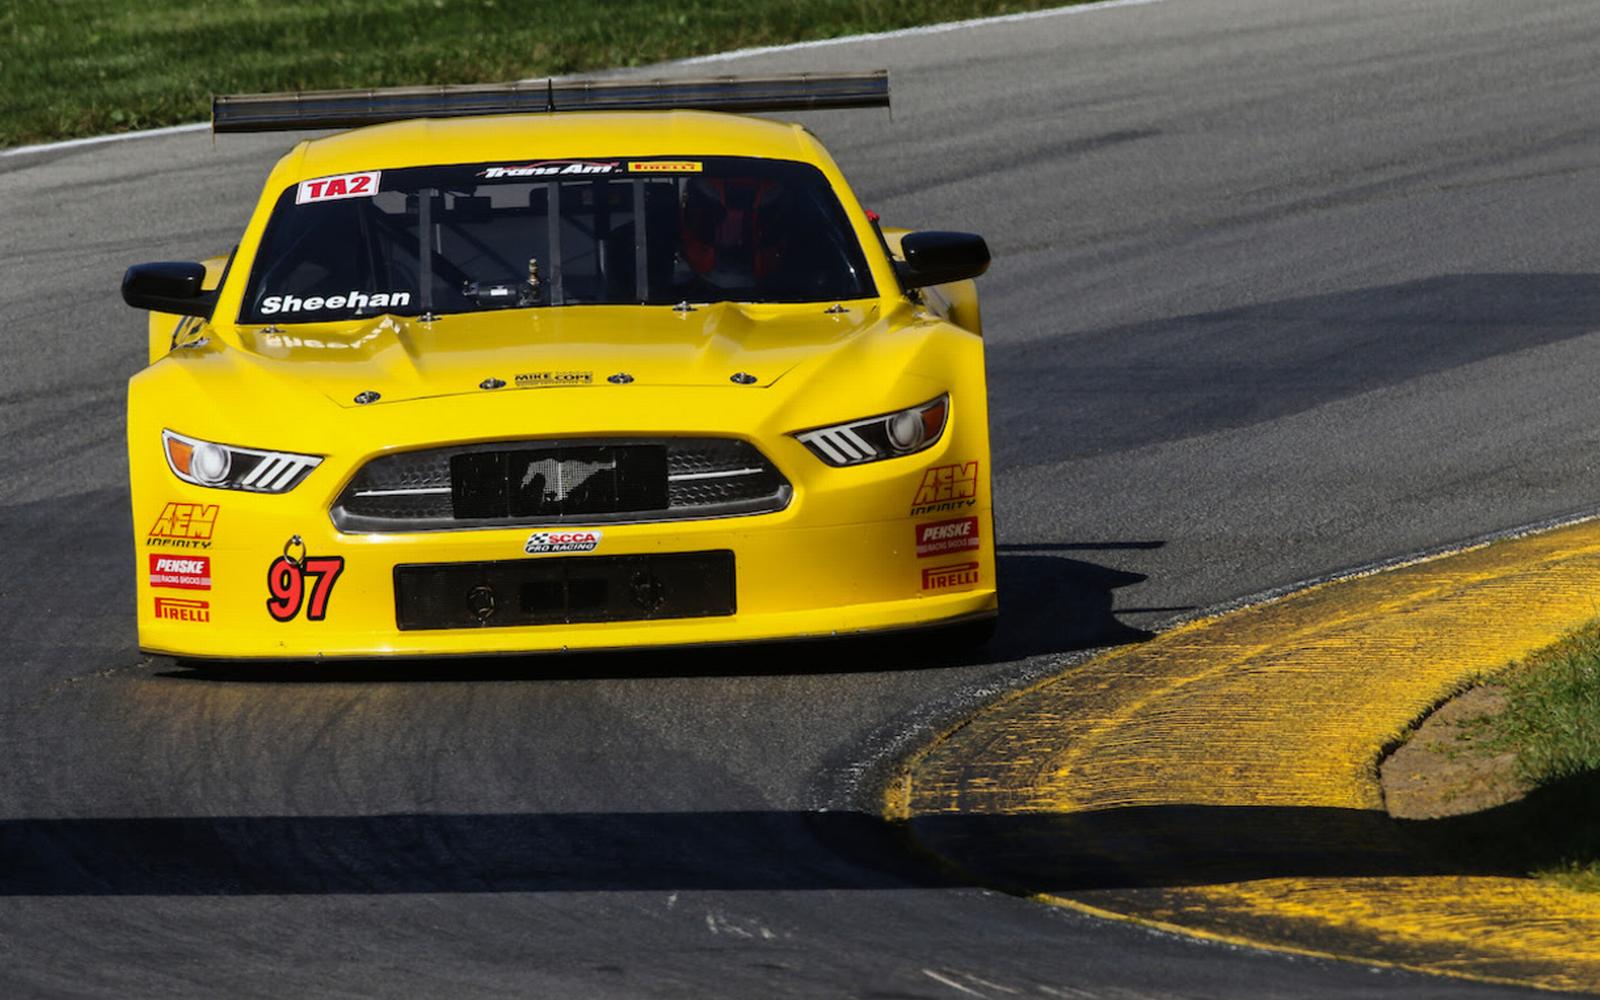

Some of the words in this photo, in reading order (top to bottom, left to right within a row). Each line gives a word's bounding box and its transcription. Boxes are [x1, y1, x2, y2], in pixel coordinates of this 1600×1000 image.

[485, 167, 560, 178] Trans
[560, 163, 612, 174] Am
[308, 176, 371, 198] TA2
[261, 291, 410, 315] Sheehan
[515, 373, 549, 382] MIKE
[554, 371, 592, 382] COPE
[911, 461, 978, 506] AEM
[910, 499, 976, 516] INFINITY
[149, 502, 220, 539] AEM
[548, 533, 596, 544] SCCA
[923, 521, 972, 541] PENSKE
[147, 538, 212, 549] INFINITY
[551, 543, 594, 552] RACING
[155, 558, 205, 574] PENSKE
[921, 561, 979, 590] PIRELLI
[266, 555, 345, 623] 97
[154, 597, 210, 622] PIRELLI
